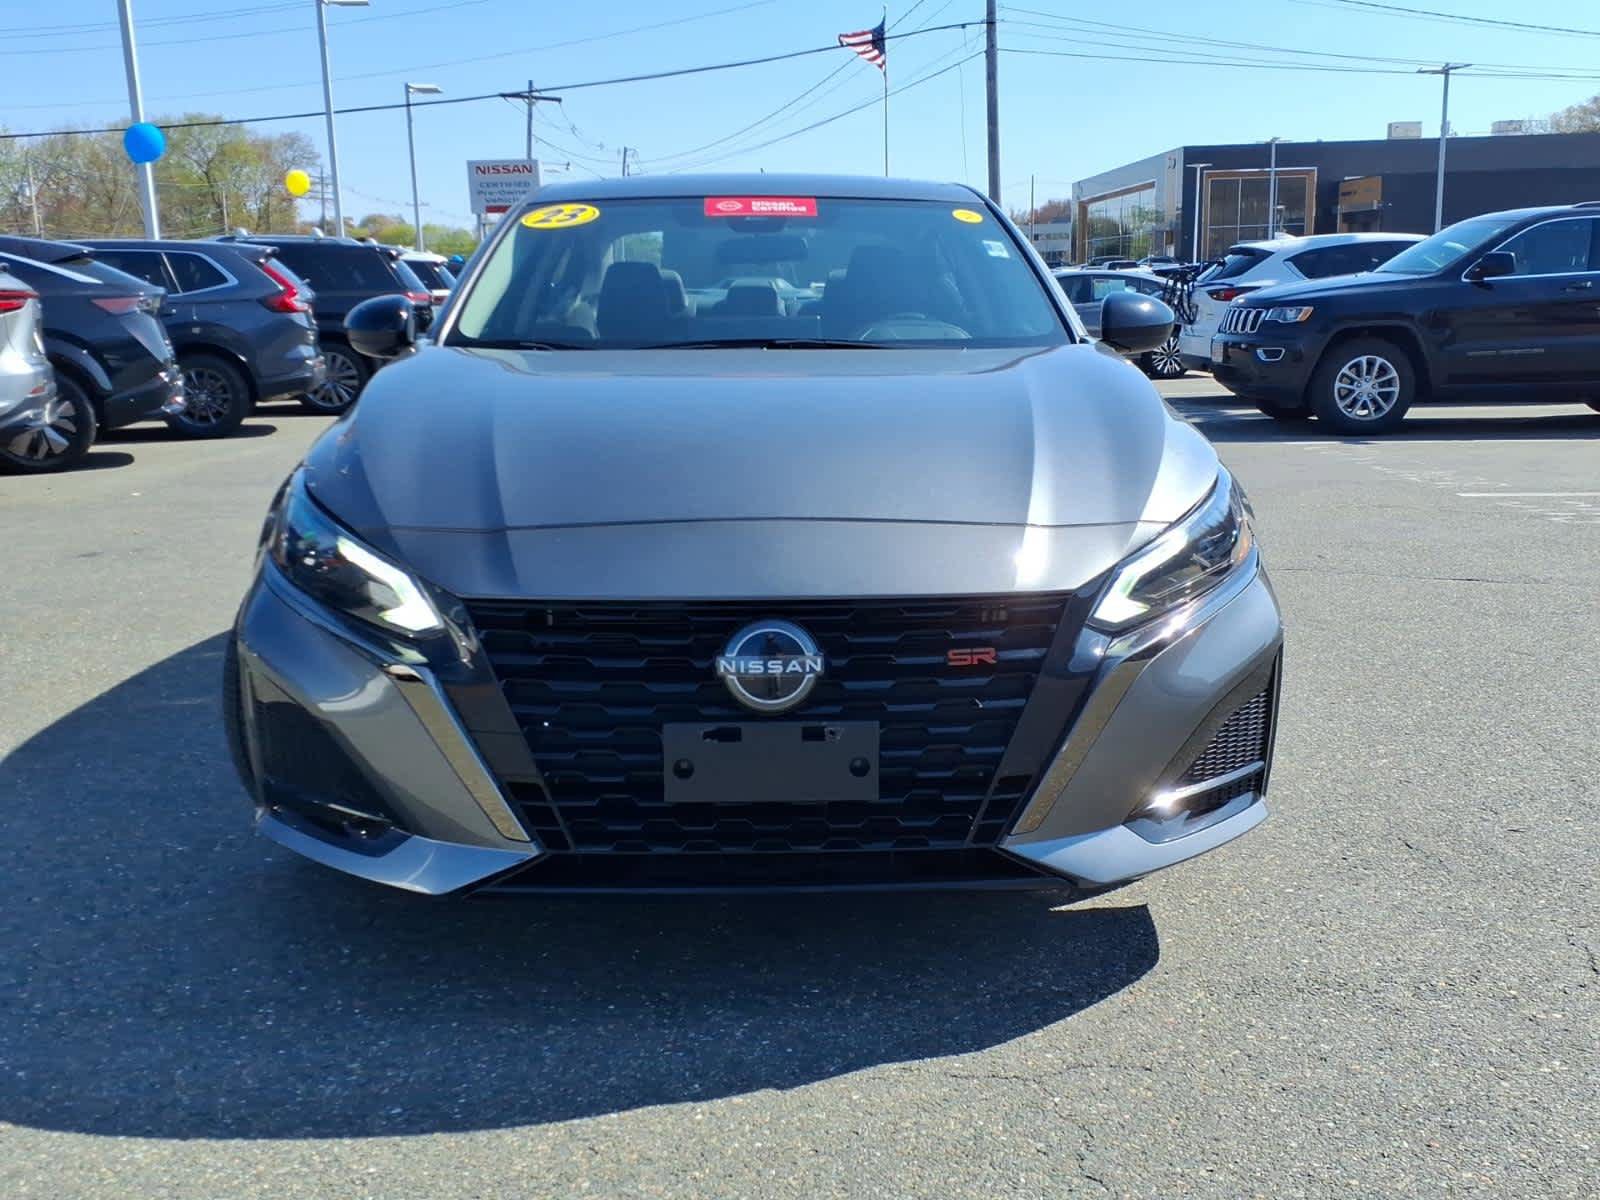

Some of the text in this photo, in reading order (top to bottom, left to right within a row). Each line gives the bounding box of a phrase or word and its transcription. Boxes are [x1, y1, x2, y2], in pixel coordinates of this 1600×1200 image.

[475, 164, 533, 175] NISSAN
[533, 207, 587, 224] 23
[947, 647, 997, 666] SR
[719, 658, 822, 674] NISSAN
